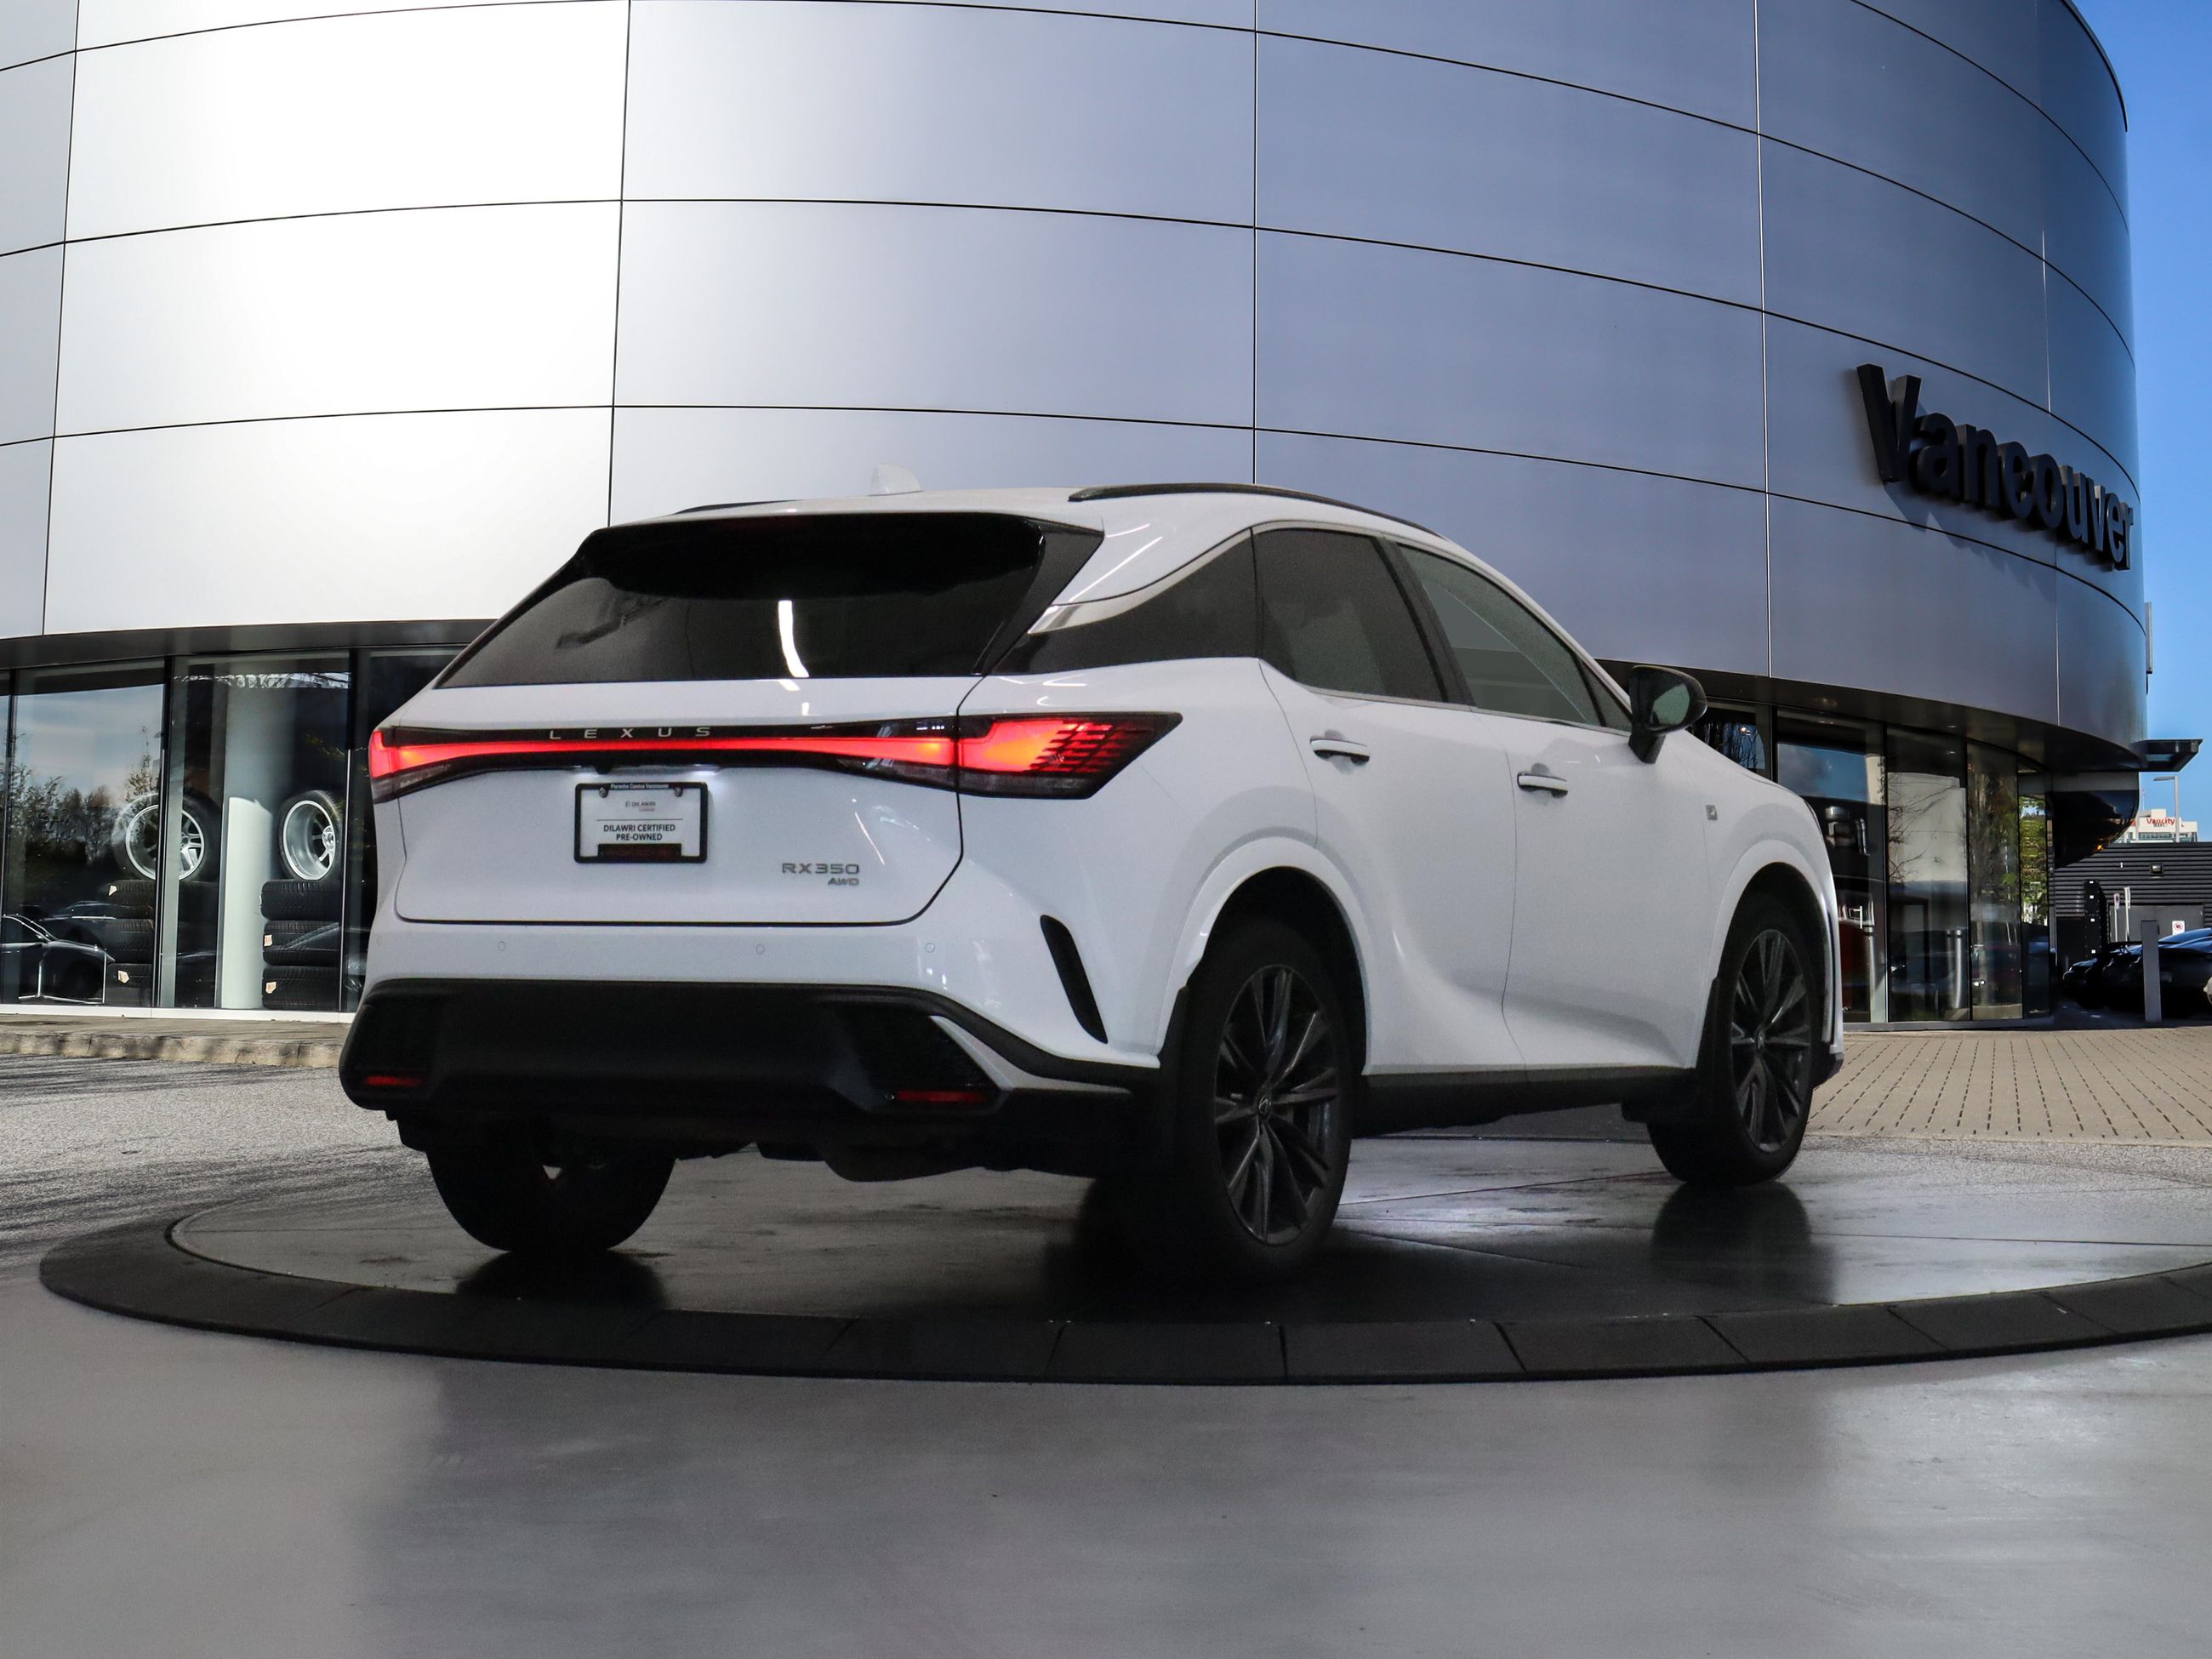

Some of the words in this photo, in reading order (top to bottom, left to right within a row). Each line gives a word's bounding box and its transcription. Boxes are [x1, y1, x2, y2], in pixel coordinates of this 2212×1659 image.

[1857, 363, 2133, 570] Vancouver
[550, 727, 710, 740] LEXUS
[637, 824, 676, 832] CERTIFIED
[782, 863, 859, 875] RX350
[828, 877, 859, 886] AWD
